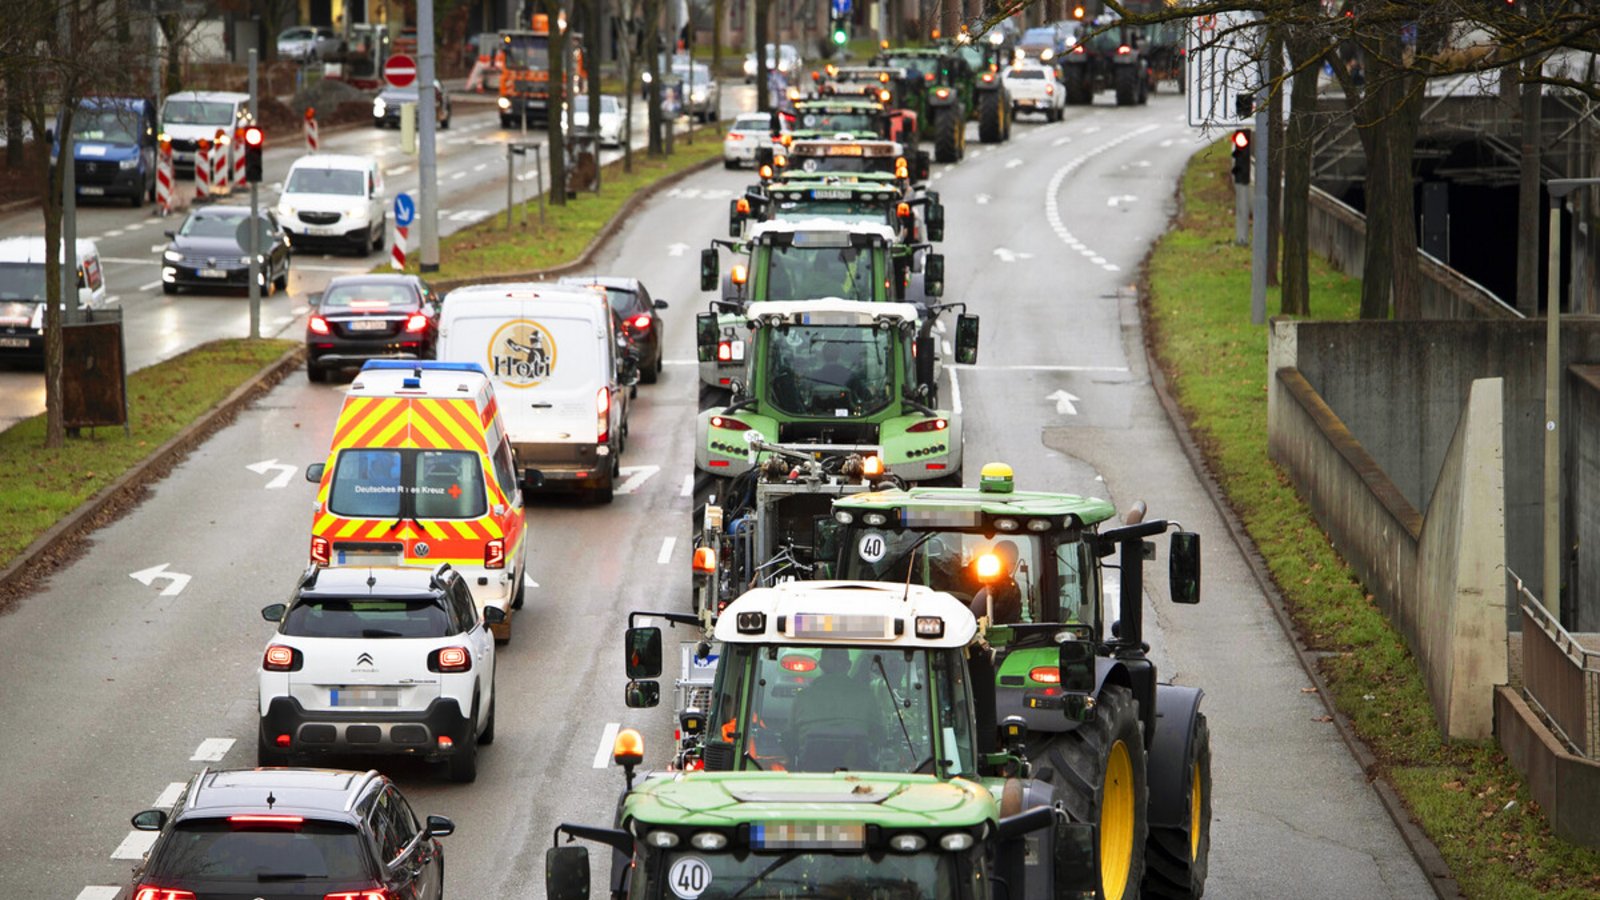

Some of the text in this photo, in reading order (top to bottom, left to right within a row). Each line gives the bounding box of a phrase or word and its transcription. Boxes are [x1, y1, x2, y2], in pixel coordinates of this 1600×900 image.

[355, 485, 396, 493] Deutsches
[421, 486, 445, 494] Kreuz
[863, 538, 881, 557] 40
[678, 864, 704, 891] 40
